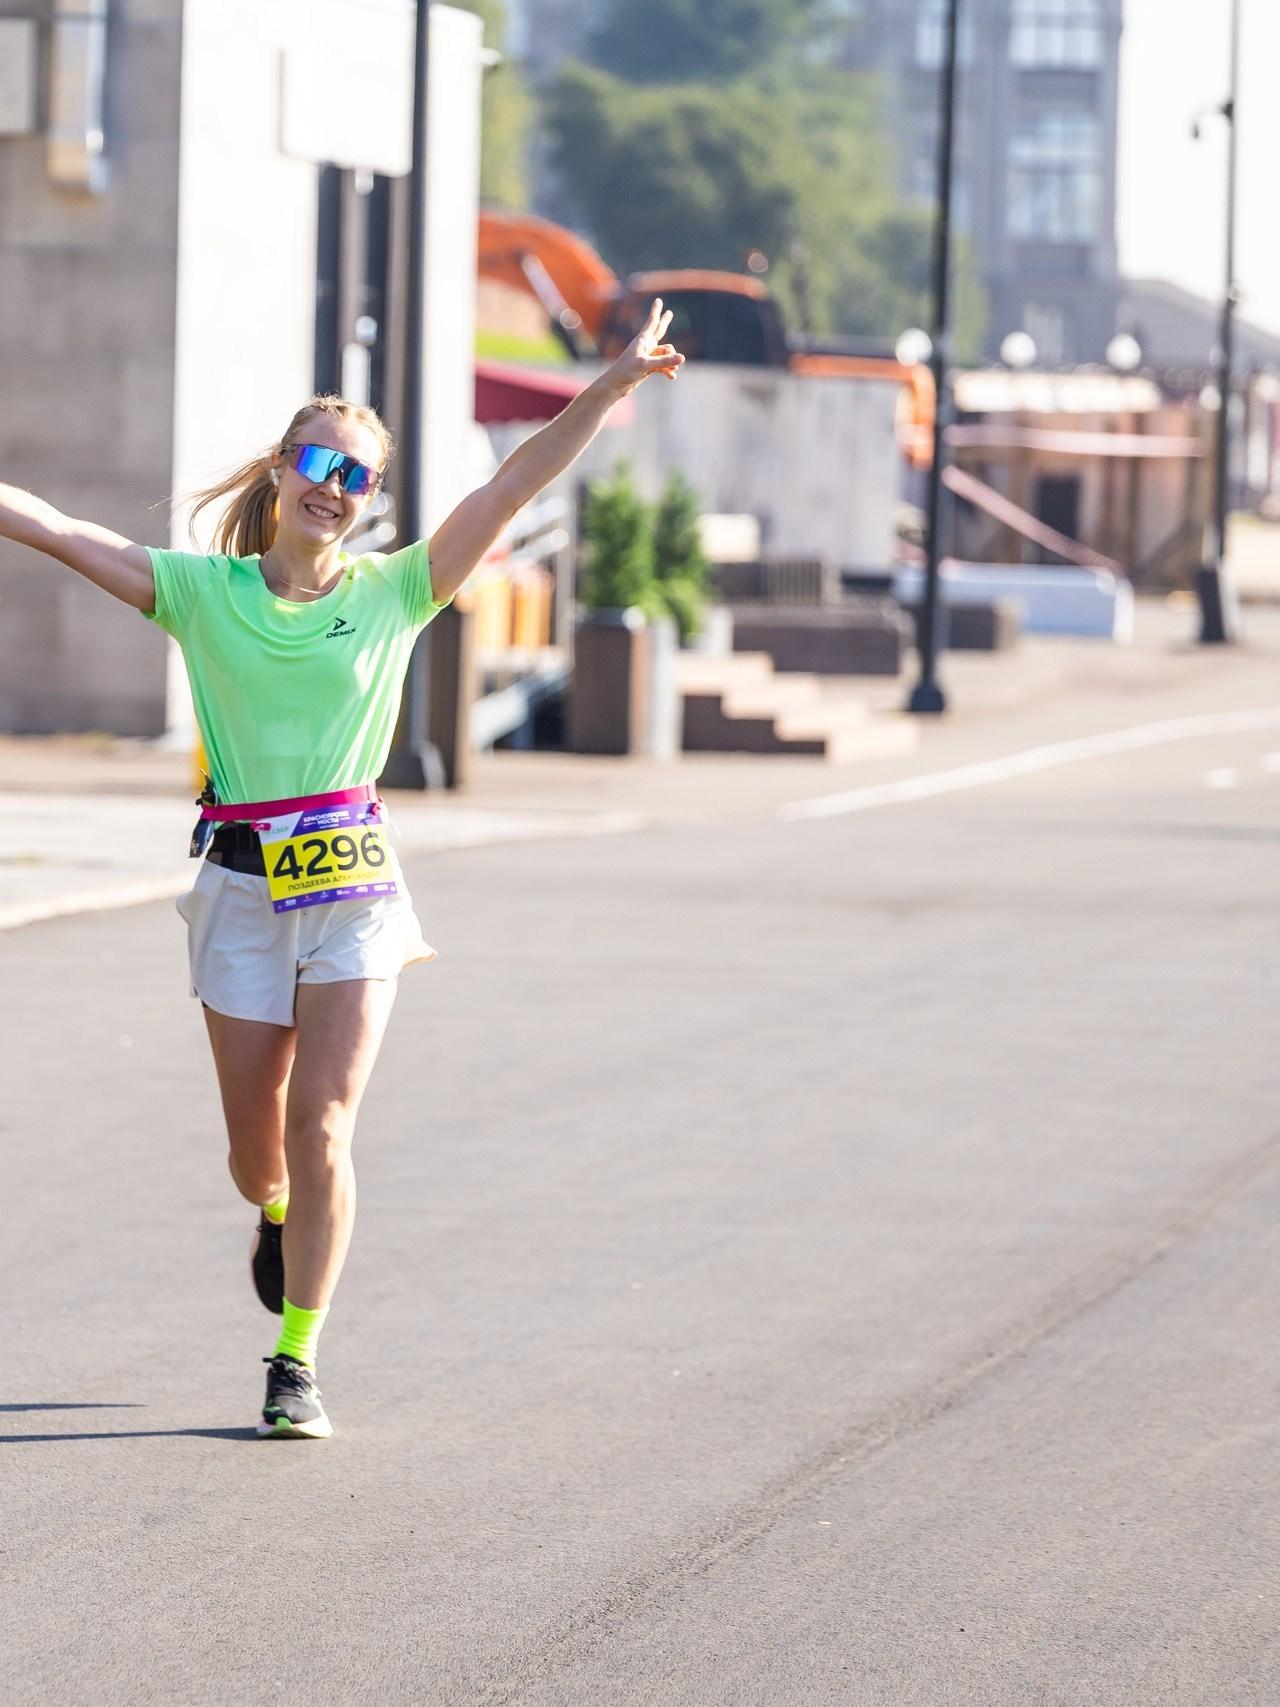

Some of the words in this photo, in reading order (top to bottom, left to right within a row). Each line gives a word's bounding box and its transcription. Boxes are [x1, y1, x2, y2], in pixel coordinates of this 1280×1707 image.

[326, 627, 357, 639] DEMIX
[273, 832, 385, 880] 4296
[288, 877, 332, 892] ПОЗДЕЕВА
